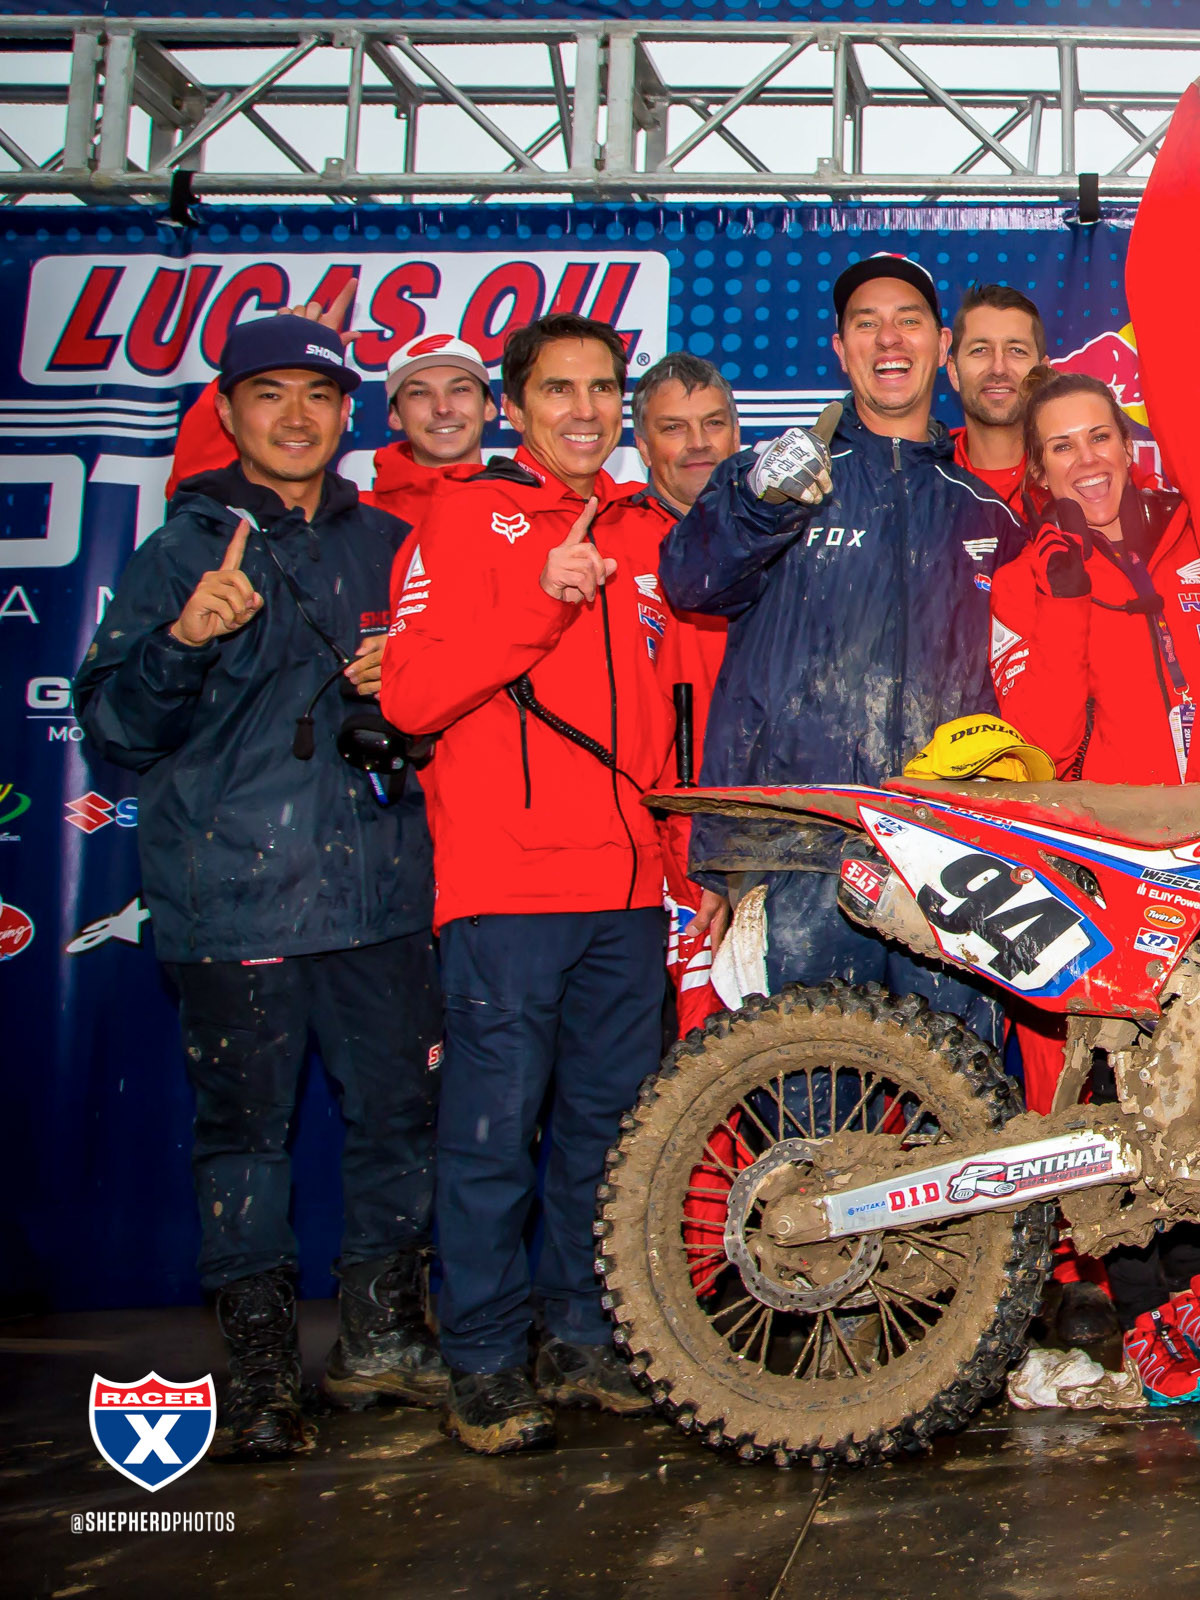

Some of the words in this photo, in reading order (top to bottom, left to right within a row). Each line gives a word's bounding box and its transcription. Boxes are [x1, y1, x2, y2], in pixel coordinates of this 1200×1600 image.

[806, 527, 866, 548] FOX
[844, 861, 879, 893] ヨシムラ
[917, 853, 1084, 982] 94
[1147, 909, 1169, 922] Twin
[1167, 915, 1183, 925] Air
[1148, 933, 1168, 947] TJ
[950, 1145, 1113, 1202] RENTHAL
[855, 1201, 886, 1213] YUTAKA
[888, 1182, 941, 1213] D.I.D
